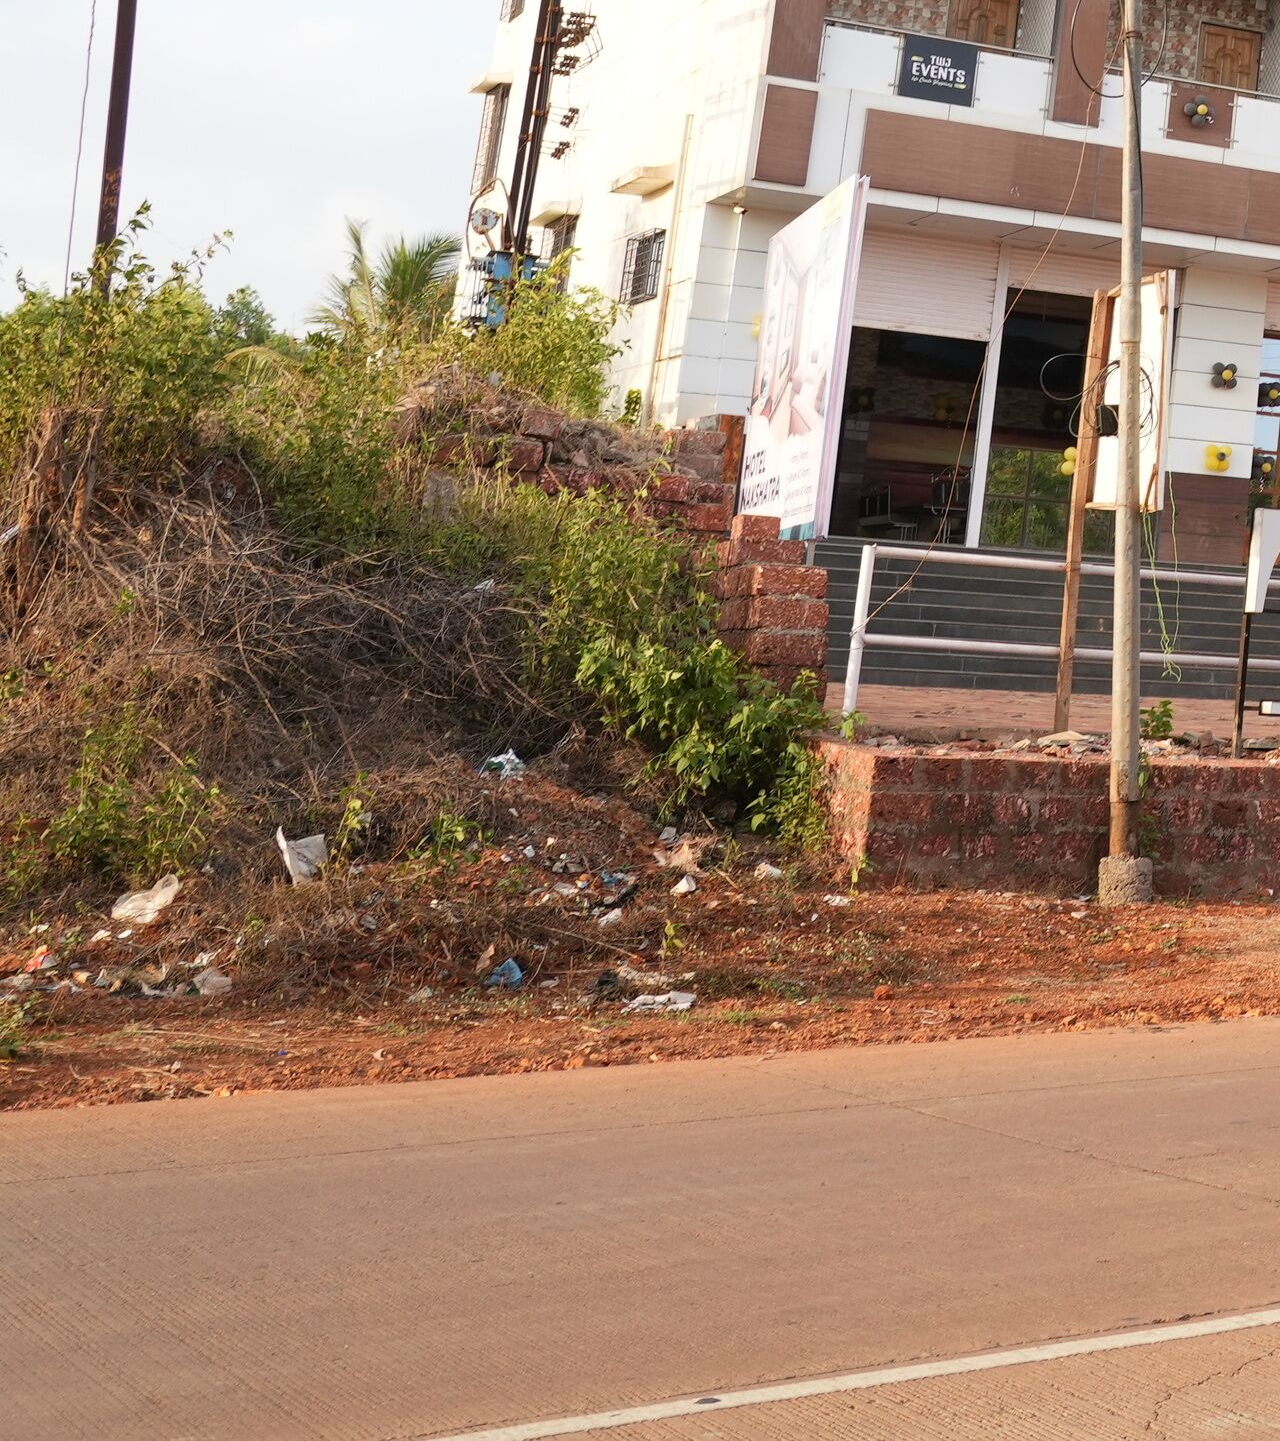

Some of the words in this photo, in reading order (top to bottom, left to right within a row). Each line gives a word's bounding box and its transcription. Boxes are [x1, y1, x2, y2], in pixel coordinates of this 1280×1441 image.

[930, 54, 952, 67] TWJ
[911, 62, 966, 83] EVENTS
[744, 449, 766, 479] HOTEL
